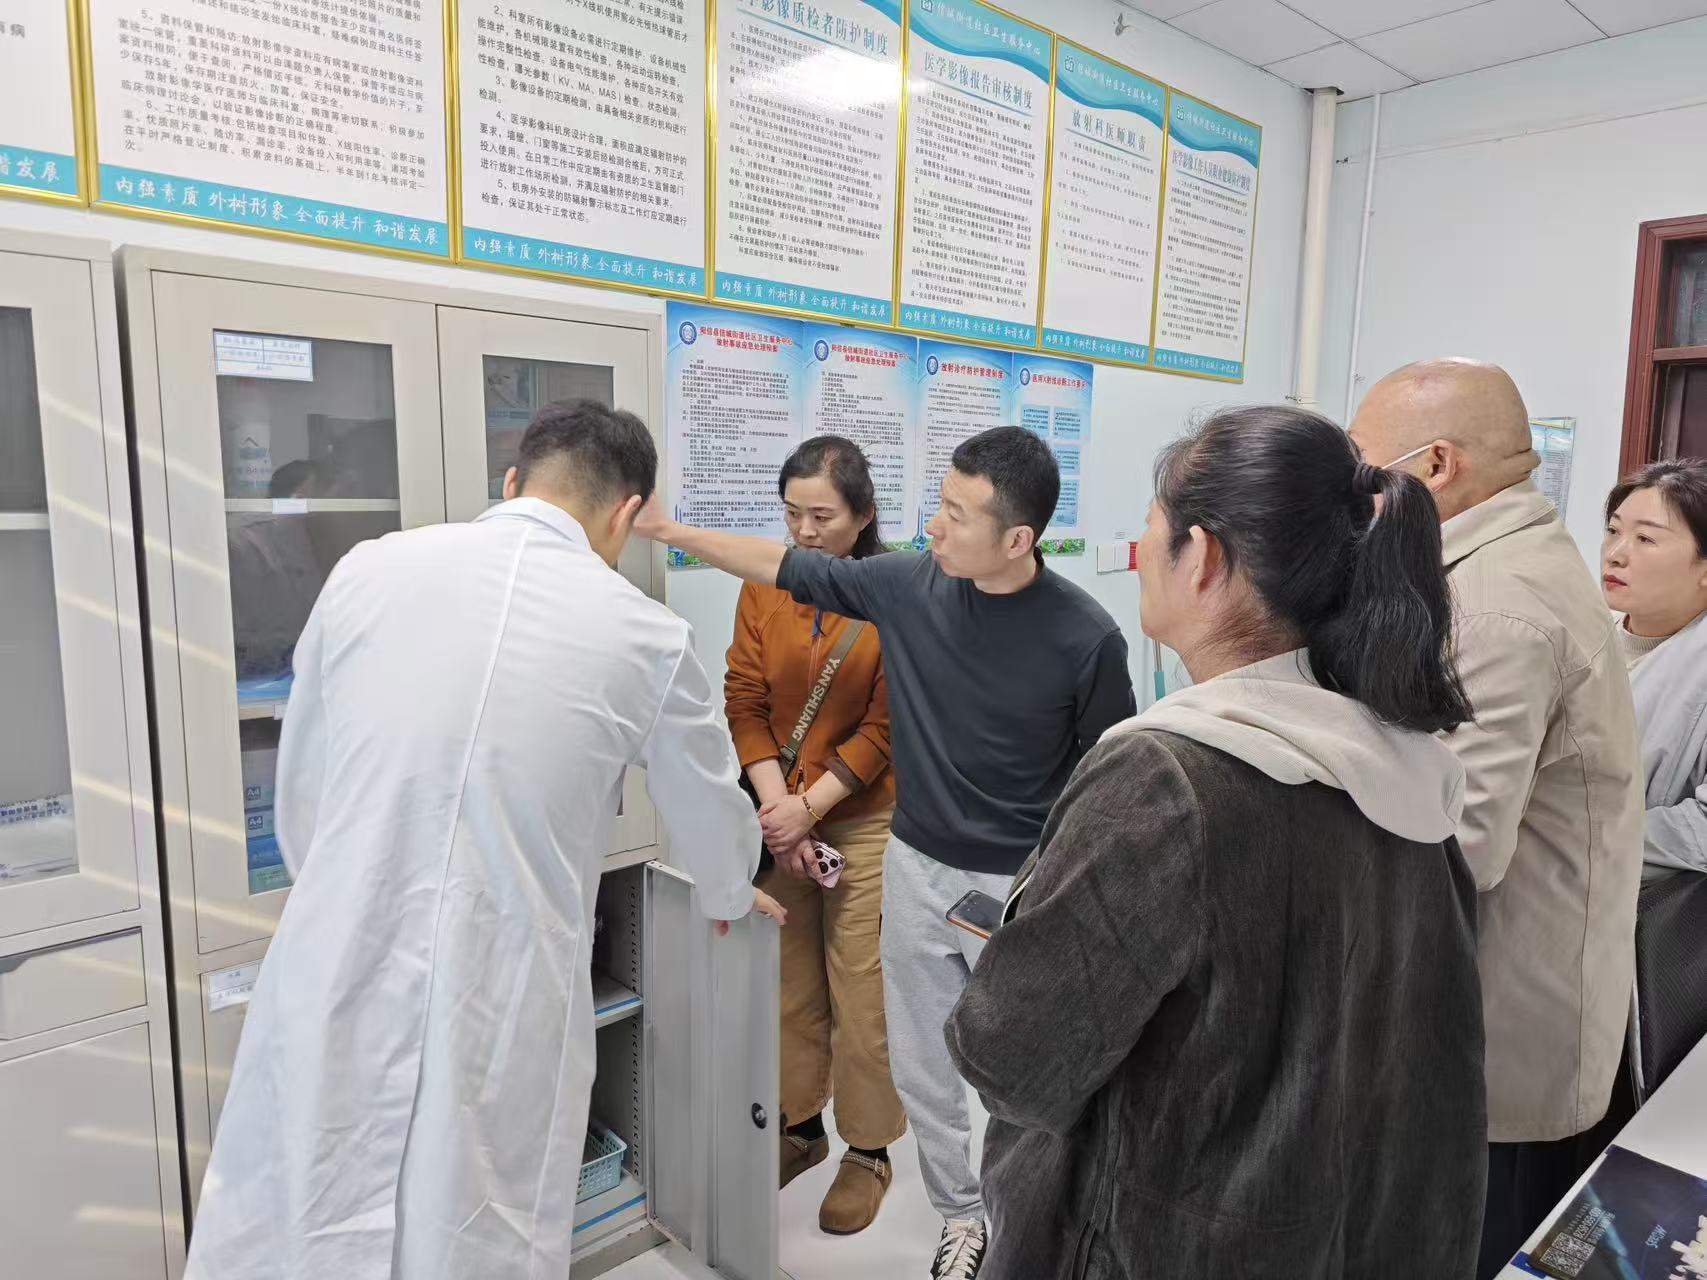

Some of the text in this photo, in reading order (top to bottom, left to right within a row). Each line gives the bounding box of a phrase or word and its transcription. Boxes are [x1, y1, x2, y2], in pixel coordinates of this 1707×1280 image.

[924, 52, 1033, 109] 医学影像报告审核制度
[1072, 109, 1146, 152] 放射科医师职责
[115, 176, 439, 245] 内强素质 外树形象 全面提升 和谐发展
[474, 237, 698, 287] 内强素质 外树形象 全面提升 和谐发展
[722, 280, 886, 318] 内强素质 外树形象 全面提升 和谐发展
[941, 362, 1005, 380] 放射诊疗防护管理制度
[792, 658, 840, 741] YANSHUANG
[247, 786, 260, 797] A4
[249, 816, 263, 826] A4
